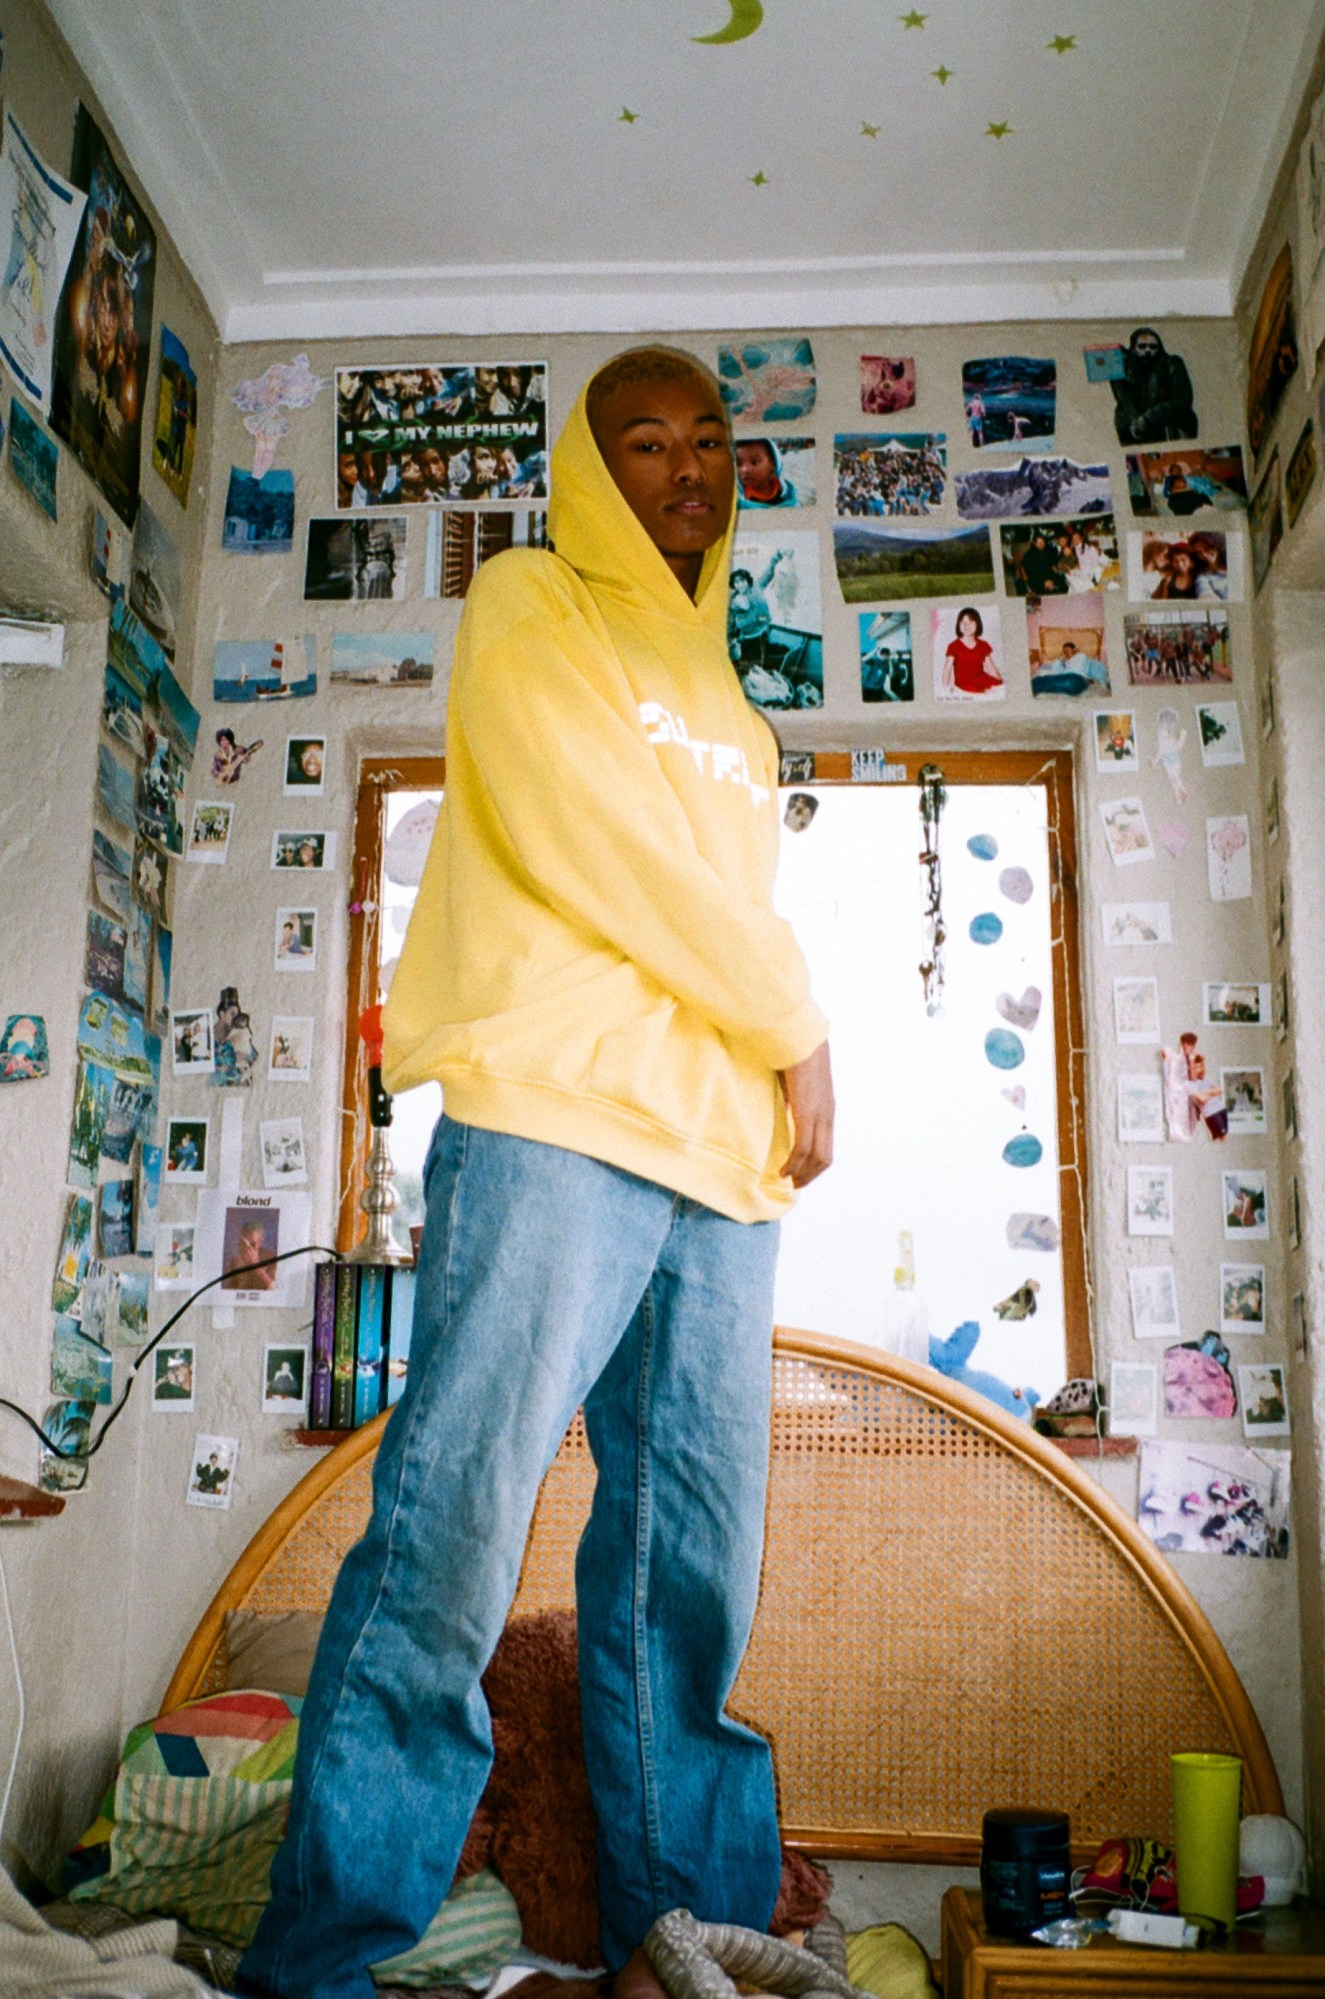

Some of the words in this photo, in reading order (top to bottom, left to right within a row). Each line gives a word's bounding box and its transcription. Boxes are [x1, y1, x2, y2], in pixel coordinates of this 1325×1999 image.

[345, 430, 353, 445] I
[394, 426, 432, 441] MY
[436, 422, 539, 439] NEPHEW
[851, 748, 886, 765] KEEP
[235, 1195, 273, 1206] blond
